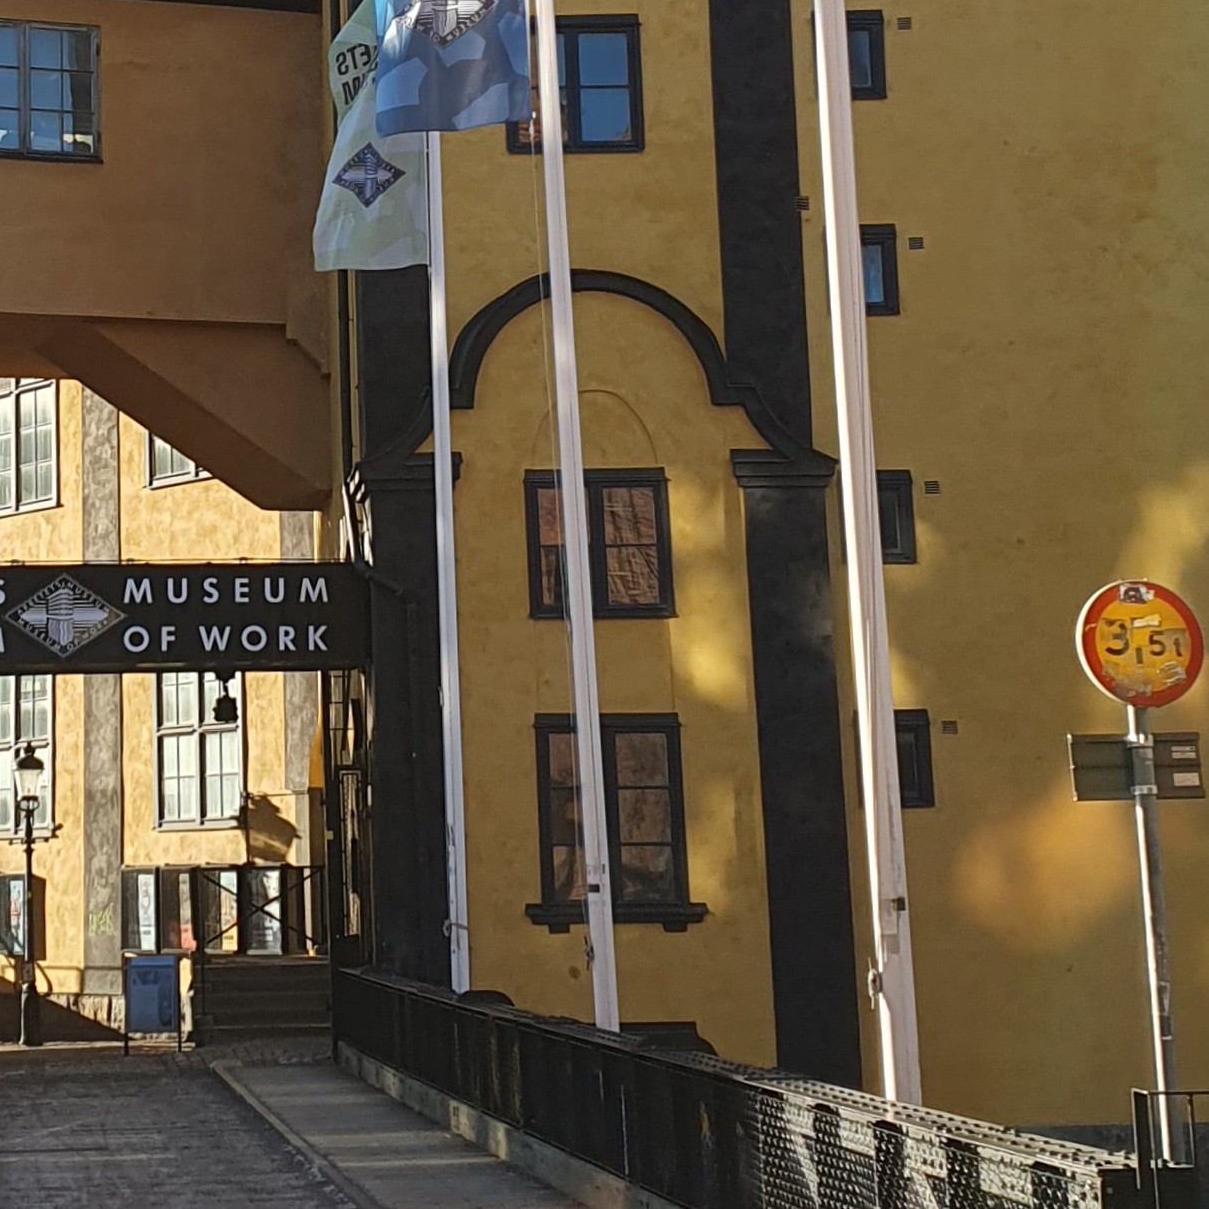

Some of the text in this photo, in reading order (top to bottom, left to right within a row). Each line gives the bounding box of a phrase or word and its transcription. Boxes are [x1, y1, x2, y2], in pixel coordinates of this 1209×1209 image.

[121, 576, 330, 605] MUSEUM
[122, 624, 330, 654] OF WORK
